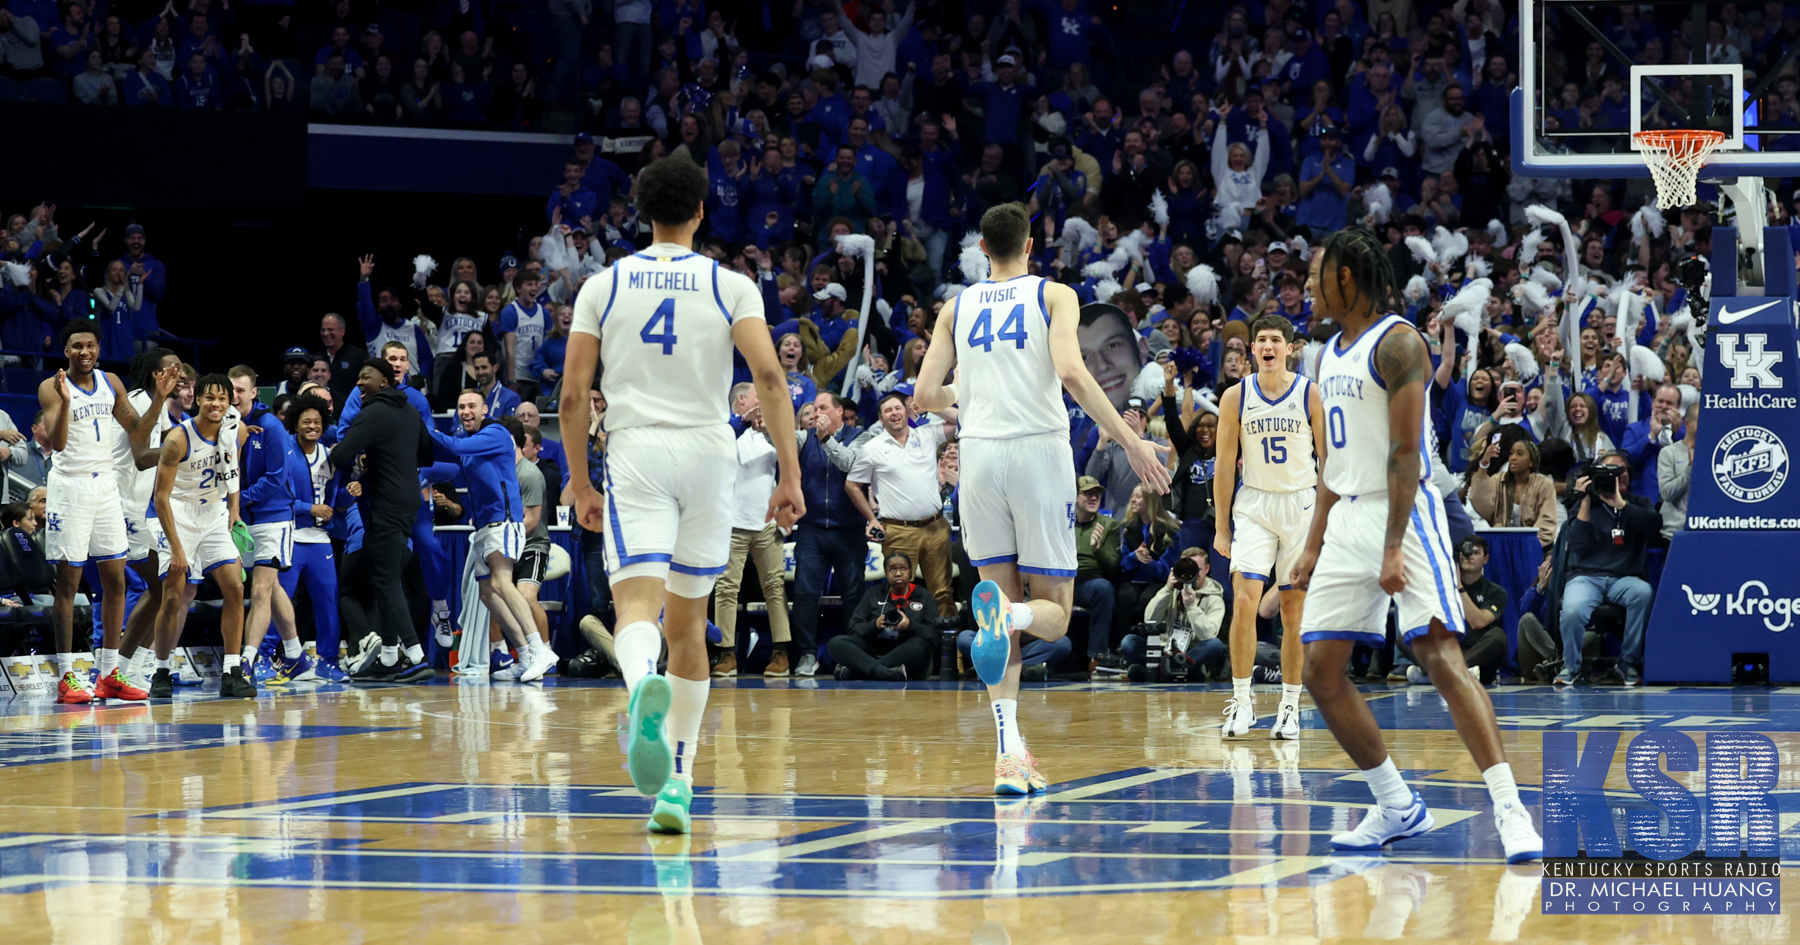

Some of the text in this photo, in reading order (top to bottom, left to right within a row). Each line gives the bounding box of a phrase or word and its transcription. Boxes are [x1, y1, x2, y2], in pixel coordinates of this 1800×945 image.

[628, 271, 699, 292] MITCHELL
[979, 286, 1017, 304] IVISIC
[639, 297, 678, 356] 4
[967, 303, 1028, 353] 44
[1704, 392, 1797, 409] HealthCare
[92, 417, 101, 442] 1
[1244, 417, 1302, 435] KENTUCKY
[1329, 405, 1347, 449] 0
[1261, 436, 1288, 464] 15
[1720, 428, 1776, 451] KENTUCKY
[1732, 452, 1770, 476] KFB
[1719, 471, 1784, 500] FARM BUREAU
[1688, 515, 1800, 530] UKathletics.co
[1726, 579, 1800, 633] Kroge
